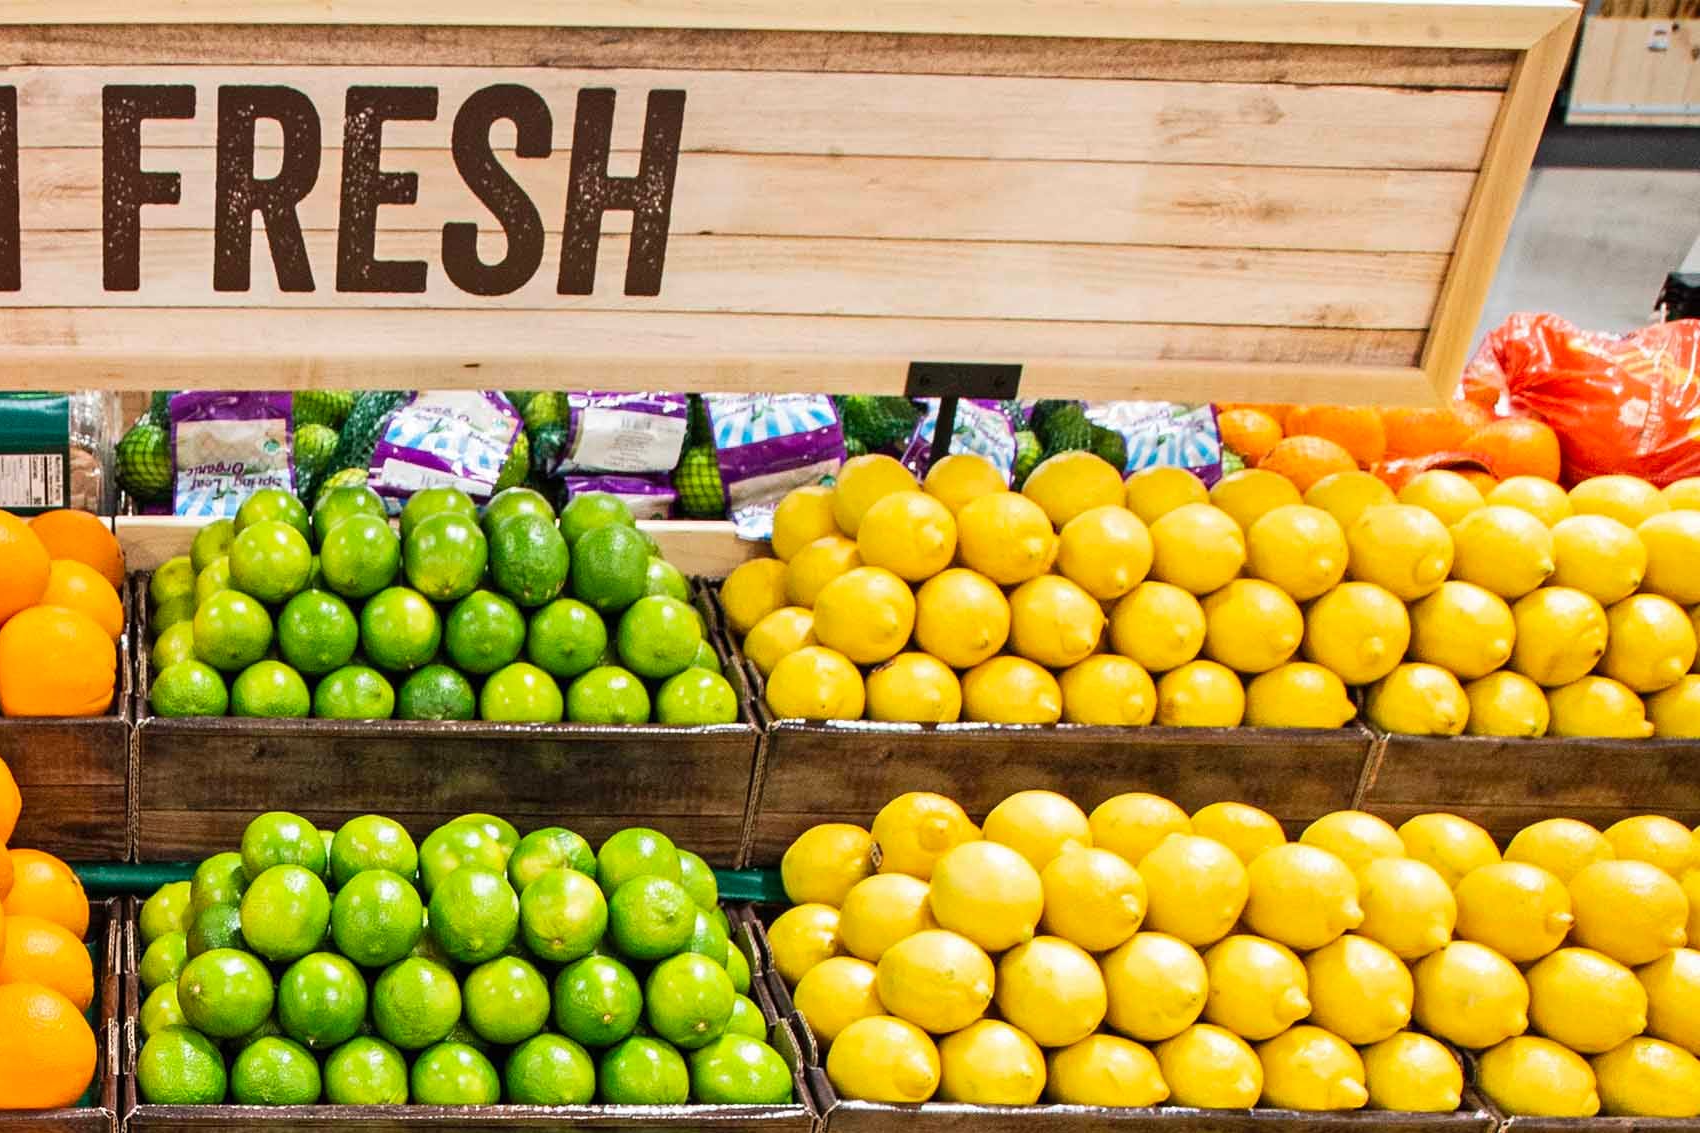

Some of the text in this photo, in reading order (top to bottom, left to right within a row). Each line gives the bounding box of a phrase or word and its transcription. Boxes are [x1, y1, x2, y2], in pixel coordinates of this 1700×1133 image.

[101, 84, 688, 296] FRESH
[187, 460, 245, 477] Organic
[188, 478, 223, 494] Leaf
